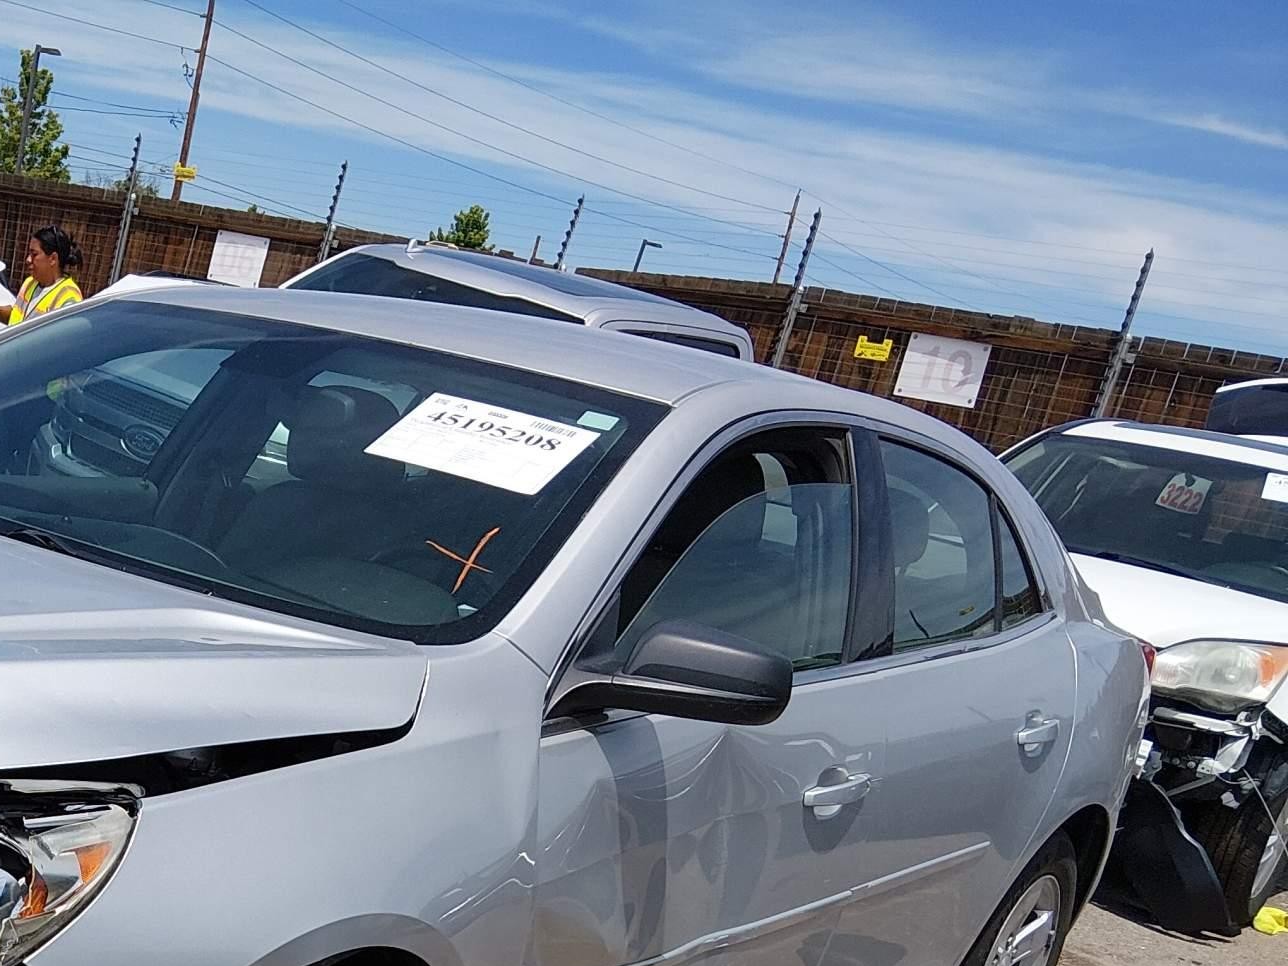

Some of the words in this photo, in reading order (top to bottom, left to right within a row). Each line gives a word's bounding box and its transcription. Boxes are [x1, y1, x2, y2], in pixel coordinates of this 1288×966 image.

[920, 345, 973, 394] 10
[427, 411, 561, 451] 45195208
[1159, 482, 1203, 513] 3222
